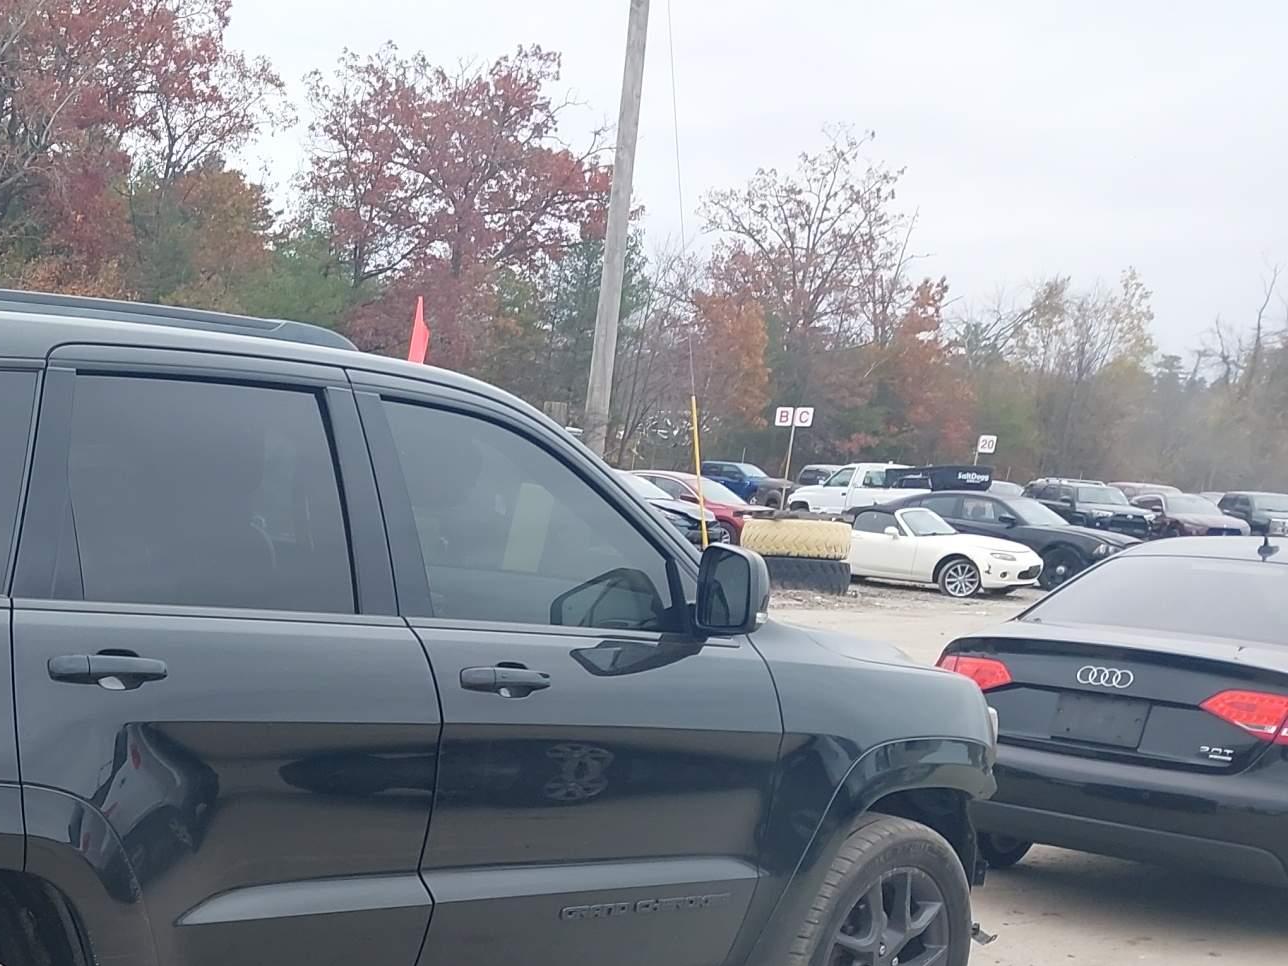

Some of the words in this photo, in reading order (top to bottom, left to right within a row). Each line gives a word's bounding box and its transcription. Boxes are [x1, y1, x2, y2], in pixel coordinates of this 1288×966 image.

[779, 410, 789, 423] B
[799, 411, 810, 424] C
[980, 439, 995, 449] 20
[958, 471, 990, 482] SaltDogg
